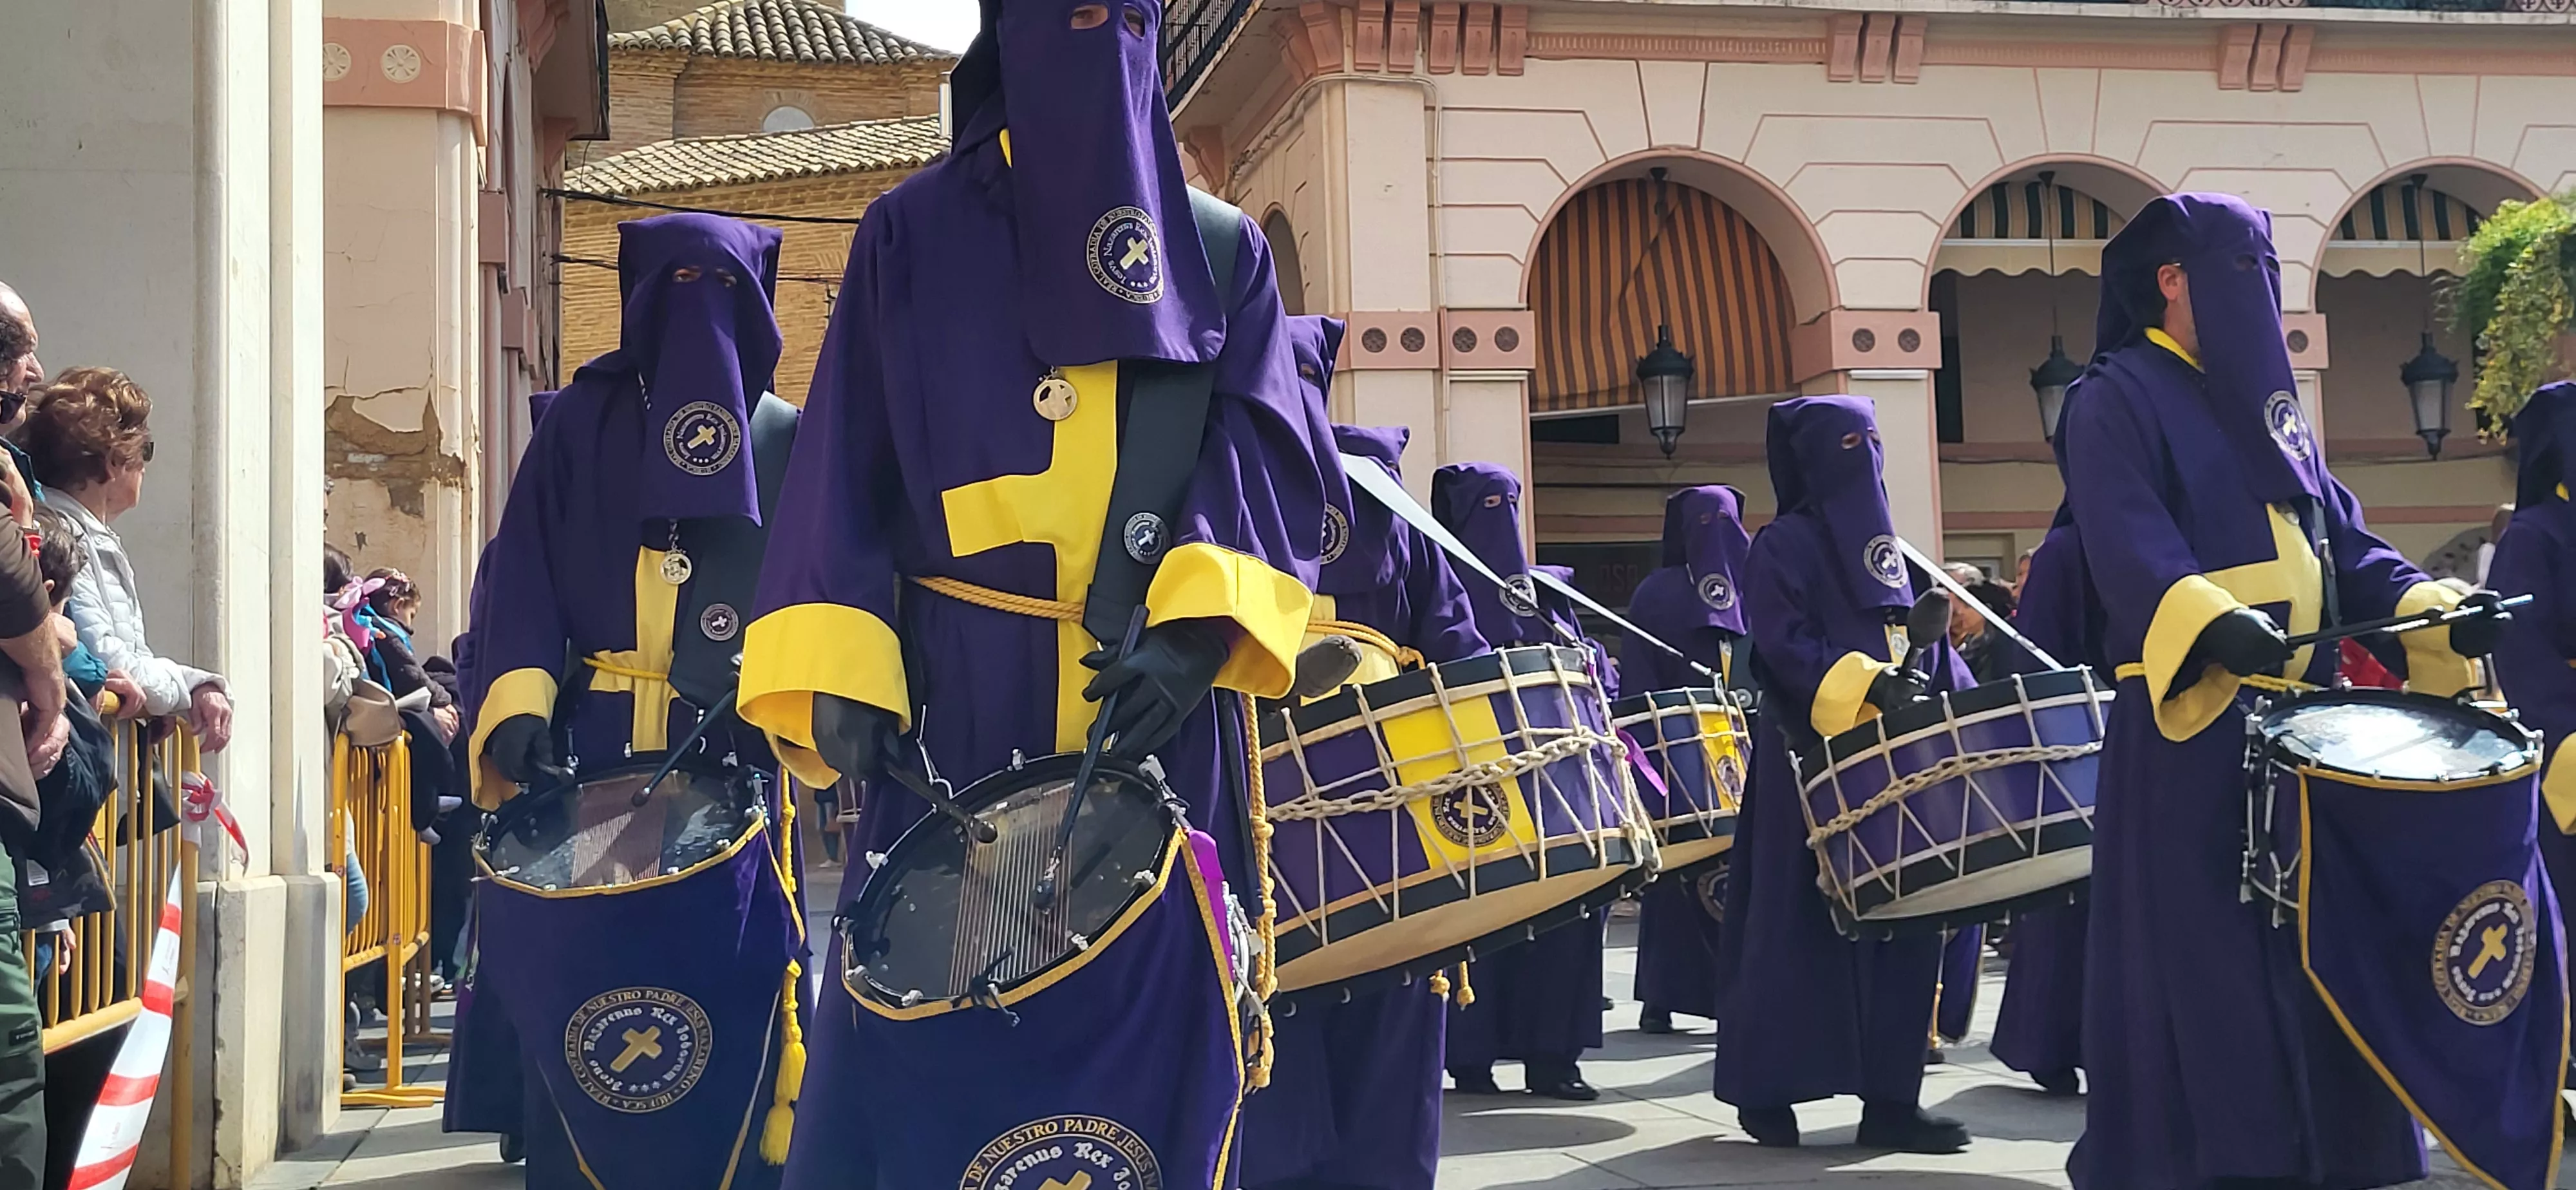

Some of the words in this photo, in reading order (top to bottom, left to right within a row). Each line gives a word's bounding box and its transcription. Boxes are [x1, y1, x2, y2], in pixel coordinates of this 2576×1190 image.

[586, 990, 641, 1014] NUESTRO
[645, 990, 685, 1007] PADRE
[967, 1161, 989, 1183] DE
[982, 1120, 1059, 1164] NUESTRO
[1063, 1119, 1121, 1141] PADRE
[1117, 1134, 1153, 1173] JESUS
[1072, 1142, 1114, 1169] Rex
